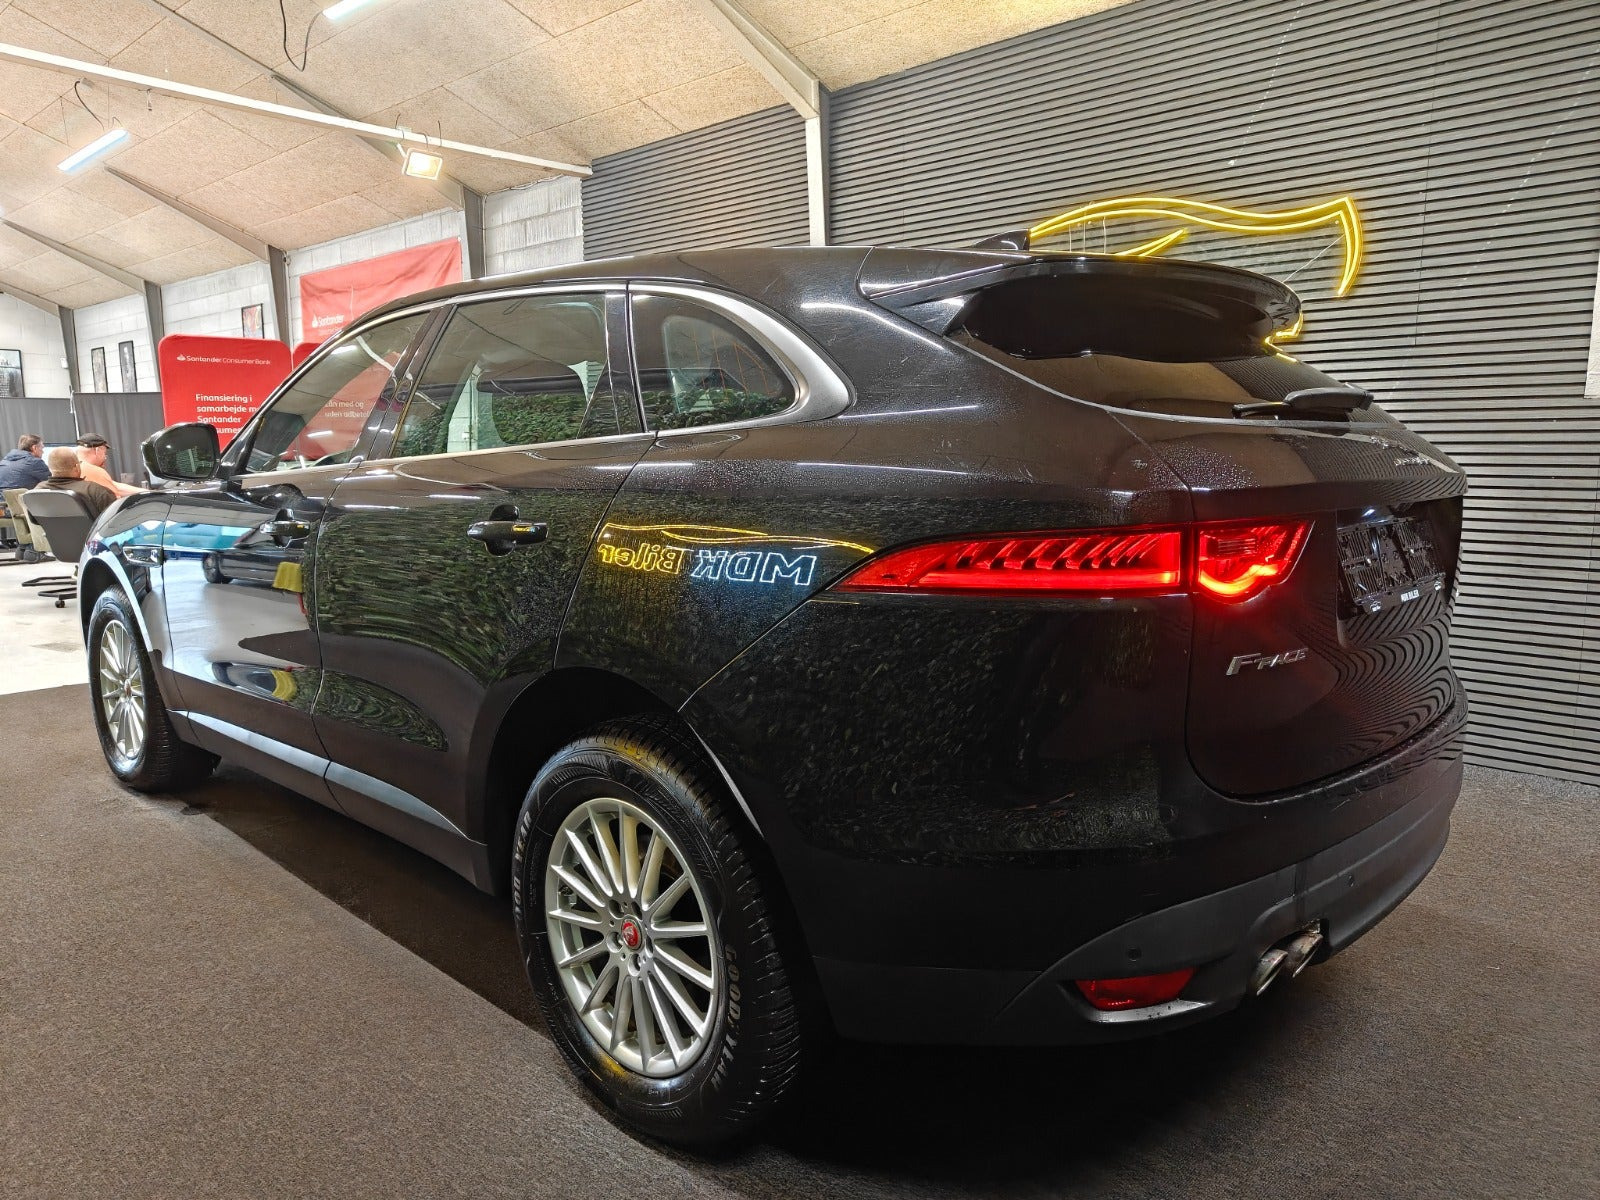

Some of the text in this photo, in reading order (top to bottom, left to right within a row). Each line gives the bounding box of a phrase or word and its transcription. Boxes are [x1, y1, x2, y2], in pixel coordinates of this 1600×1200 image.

[186, 355, 222, 363] Santander
[195, 393, 253, 404] Finansiering i
[196, 404, 247, 414] samarbejde
[197, 415, 241, 423] Santander
